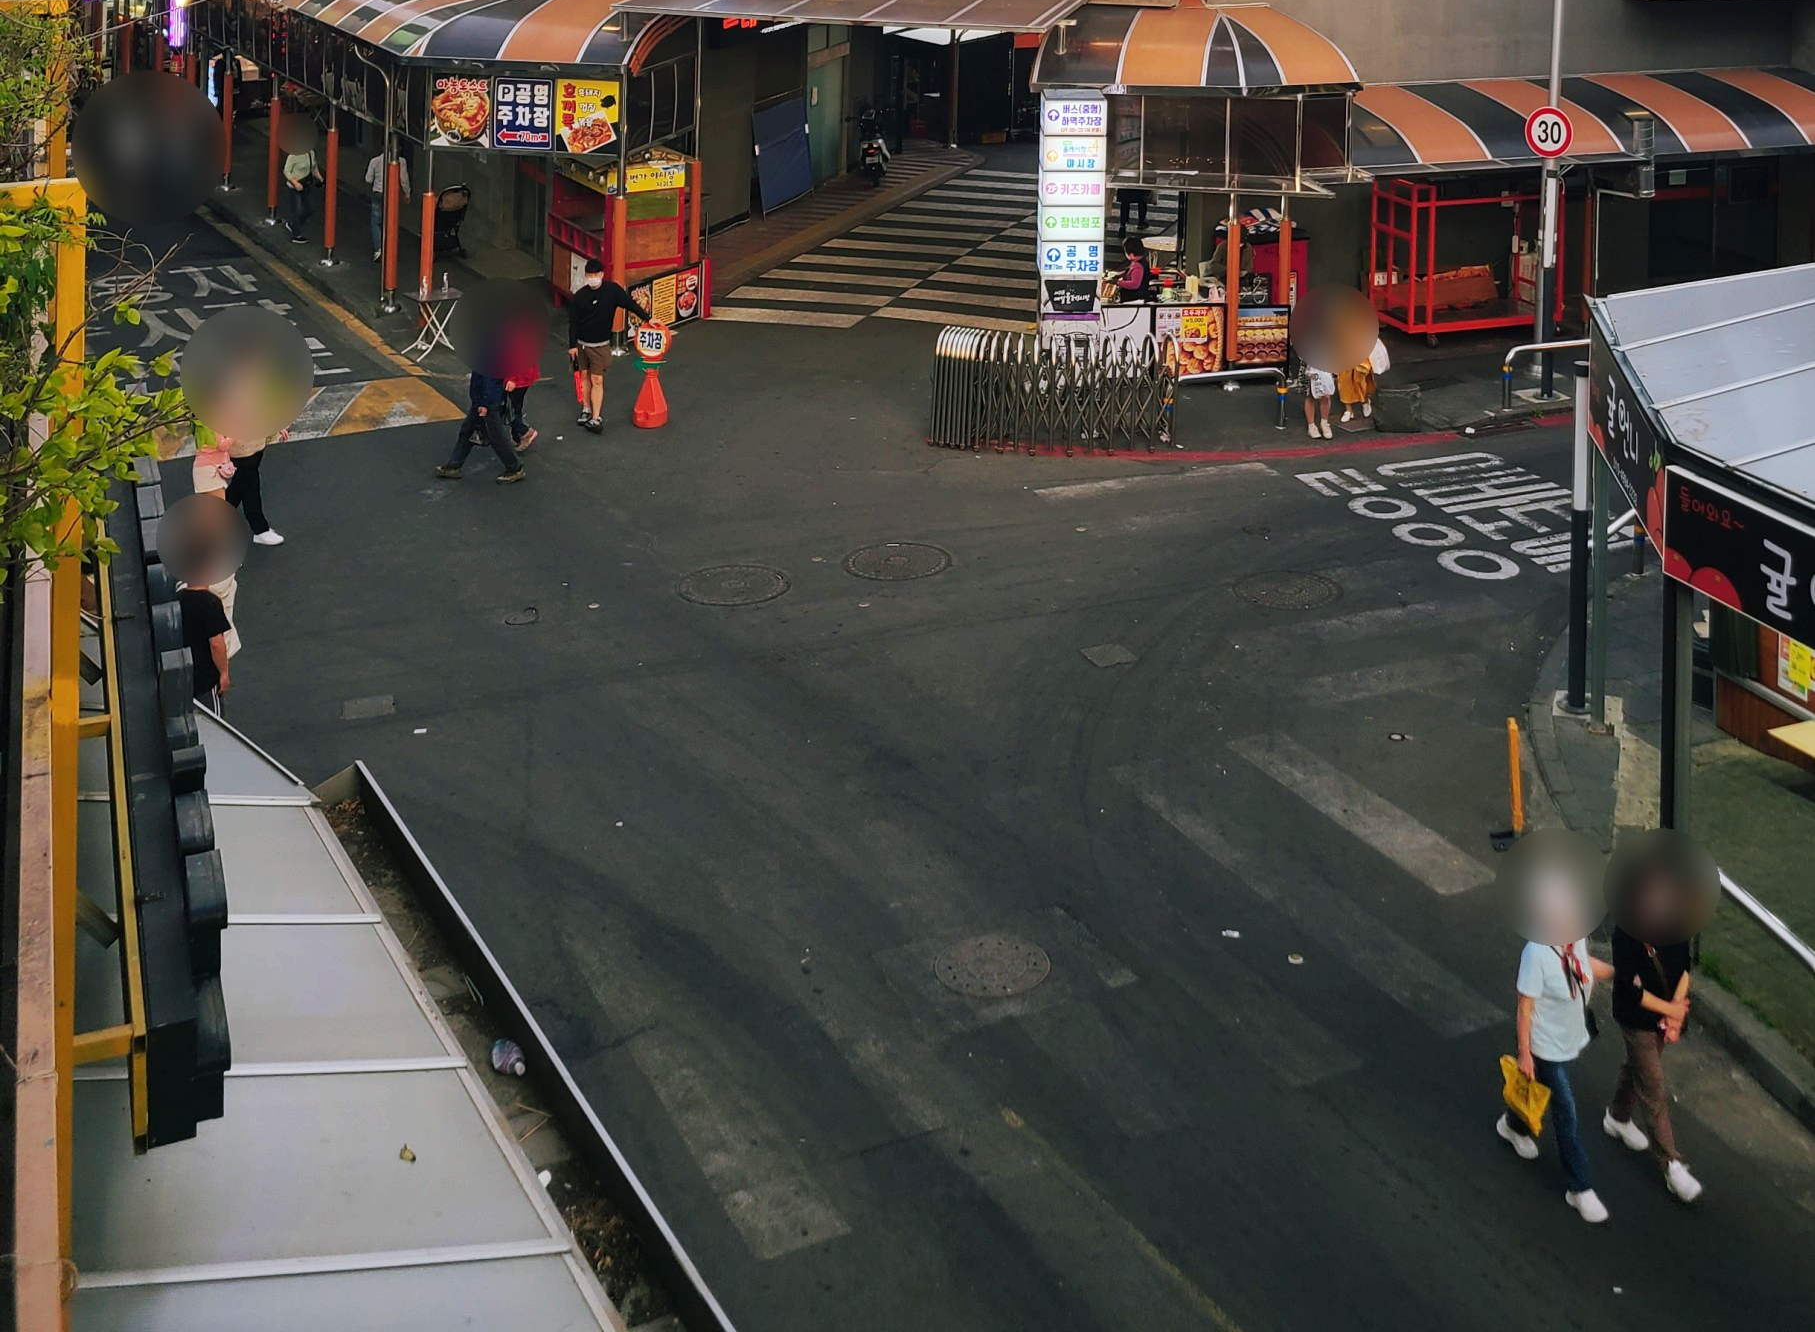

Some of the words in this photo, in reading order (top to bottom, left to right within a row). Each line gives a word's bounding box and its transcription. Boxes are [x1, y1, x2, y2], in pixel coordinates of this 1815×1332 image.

[516, 84, 549, 105] 공영
[497, 105, 549, 128] 주차장
[519, 131, 539, 142] 70m
[1538, 120, 1562, 144] 30
[1067, 158, 1095, 168] 야시장
[1060, 183, 1101, 195] 키즈카페
[1066, 259, 1099, 272] 주차장
[639, 331, 662, 349] 주차장
[1679, 485, 1745, 530] 들어와요~
[1760, 538, 1815, 620] 귤
